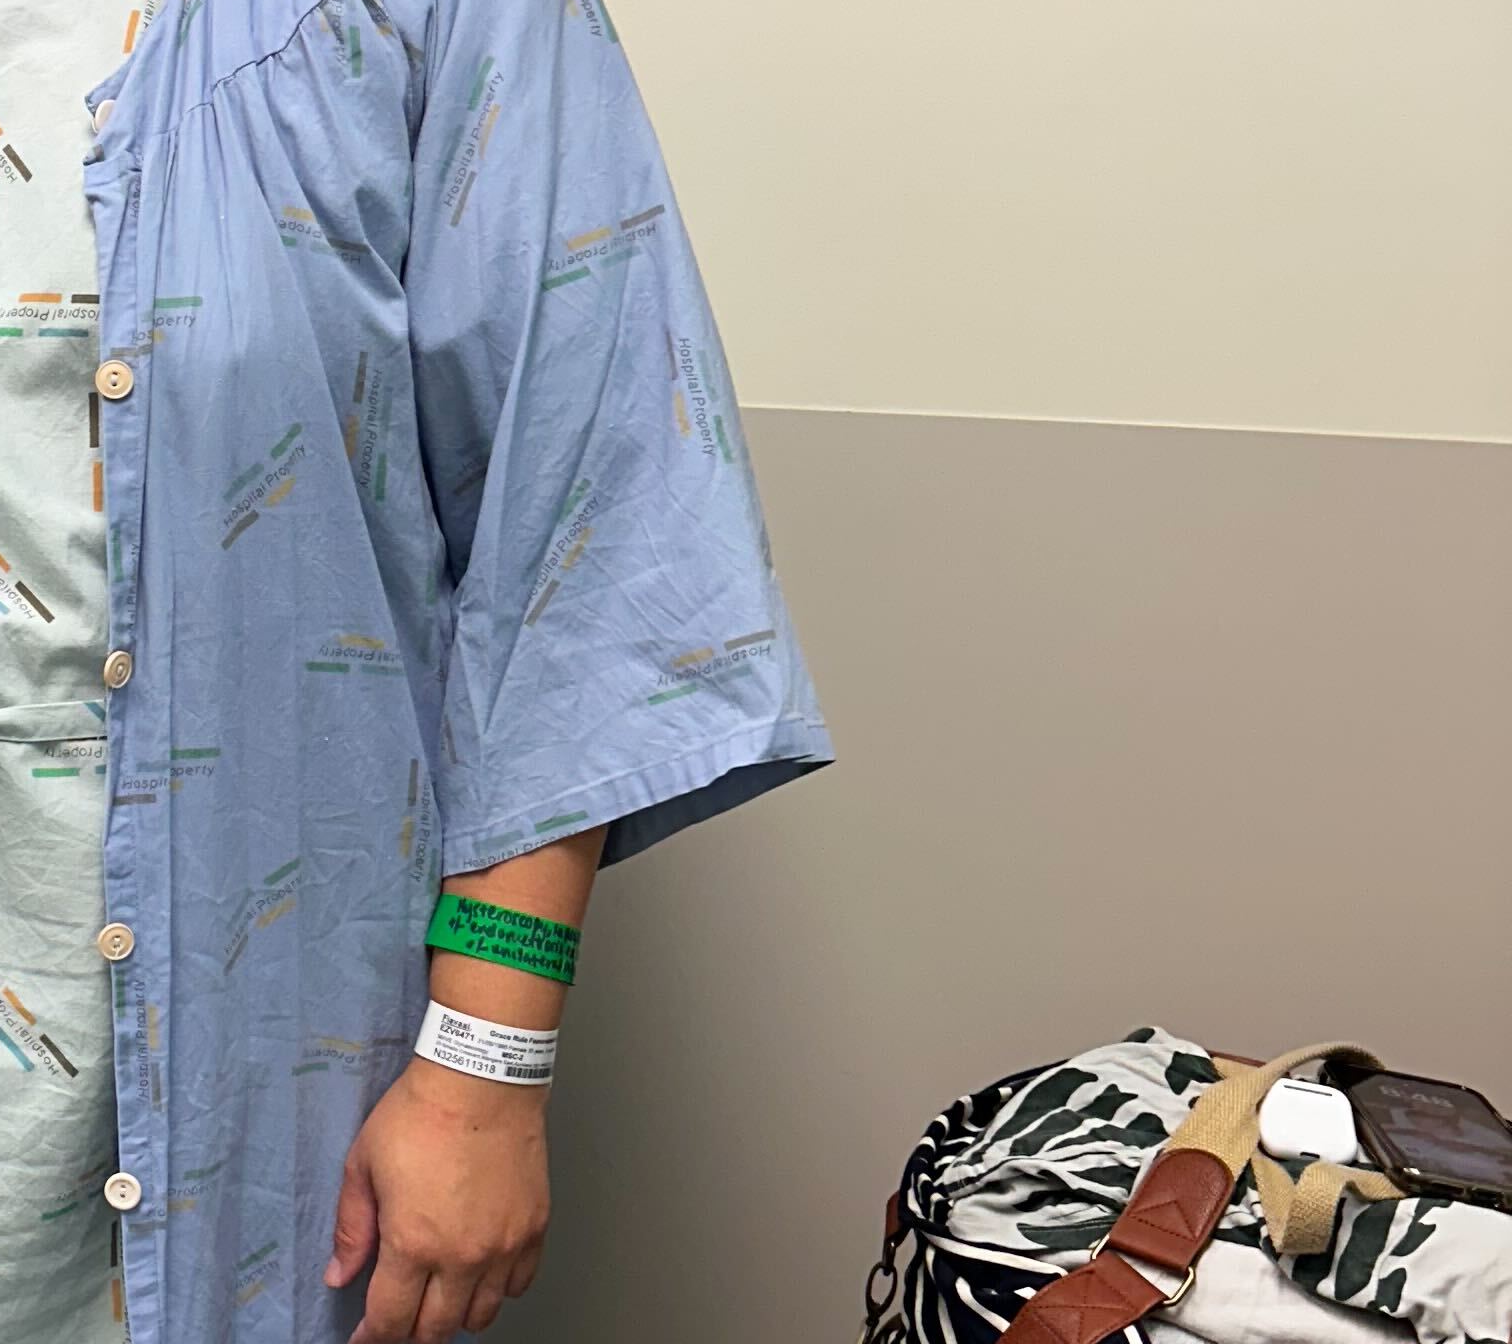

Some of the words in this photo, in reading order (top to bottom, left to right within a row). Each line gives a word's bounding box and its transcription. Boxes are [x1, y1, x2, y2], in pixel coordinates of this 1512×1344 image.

[445, 140, 478, 208] Hospital
[679, 338, 702, 397] Hospital
[691, 396, 717, 457] Property
[14, 1025, 59, 1078] Hospital
